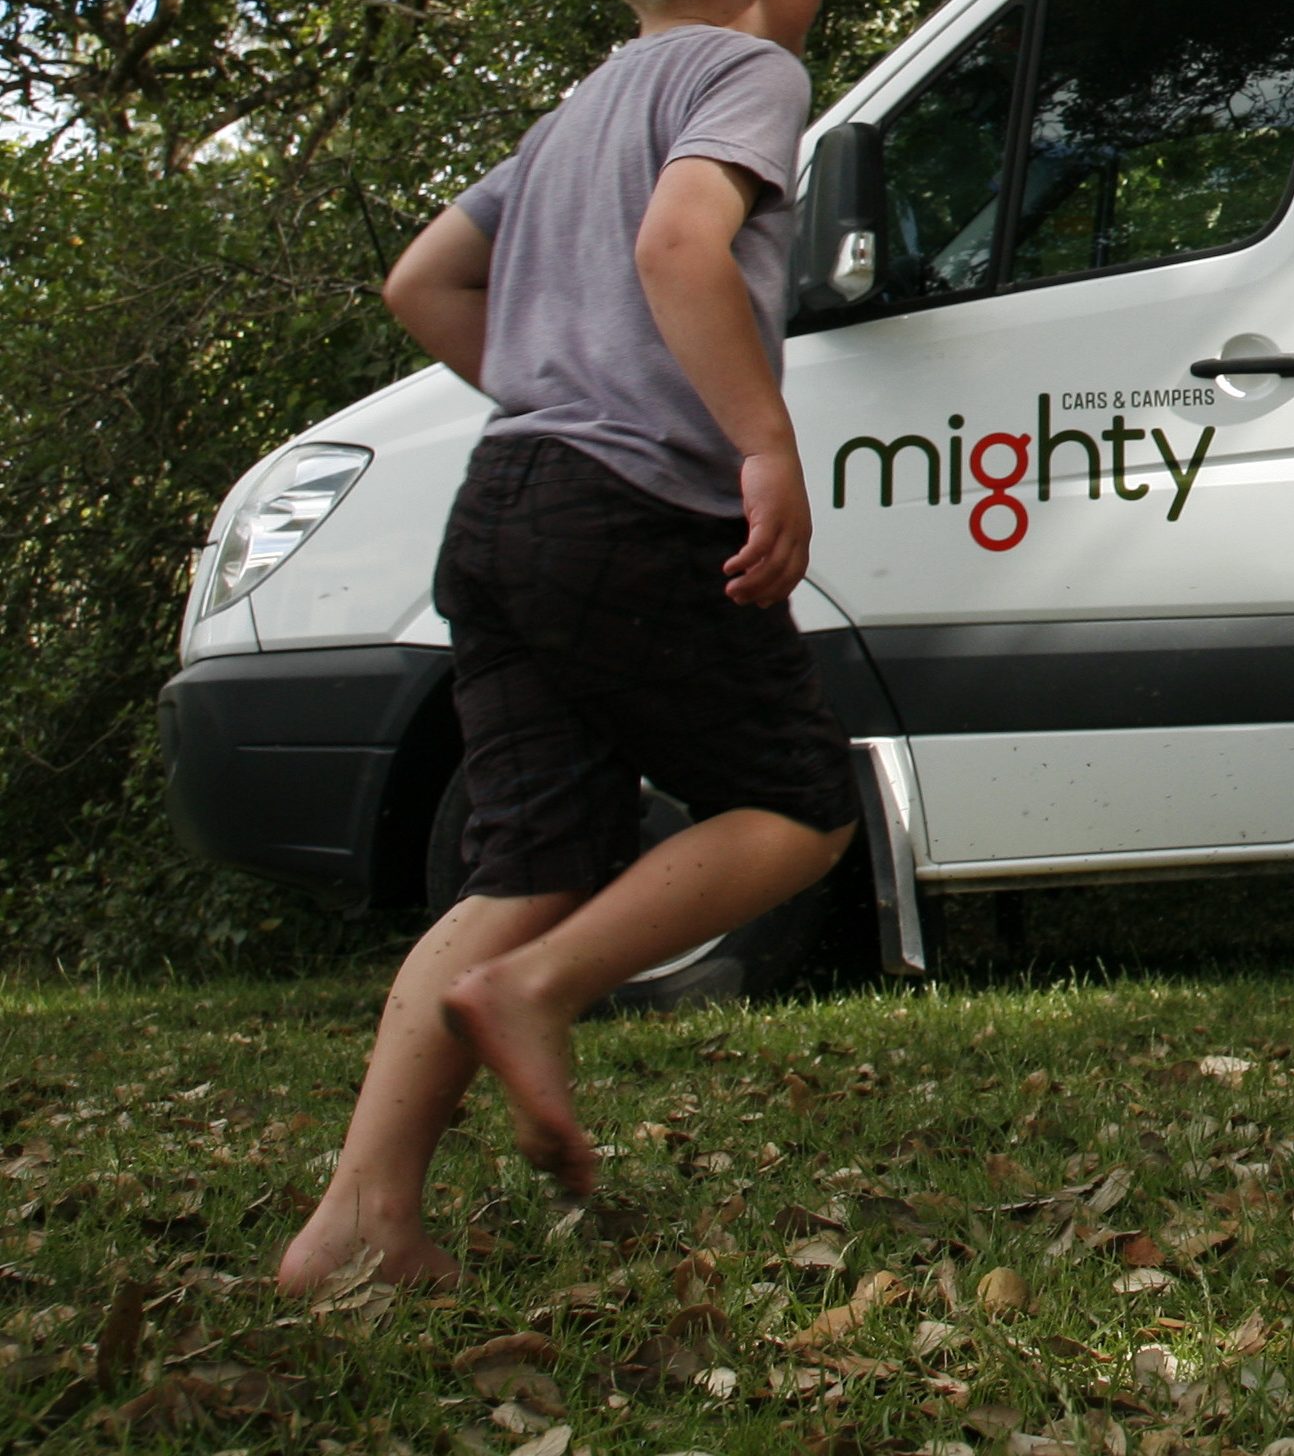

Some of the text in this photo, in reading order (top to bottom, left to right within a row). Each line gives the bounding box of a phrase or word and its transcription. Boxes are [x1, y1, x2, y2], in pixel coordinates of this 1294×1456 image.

[1062, 388, 1215, 410] CARS & CAMPERS
[832, 393, 1216, 552] mighty
